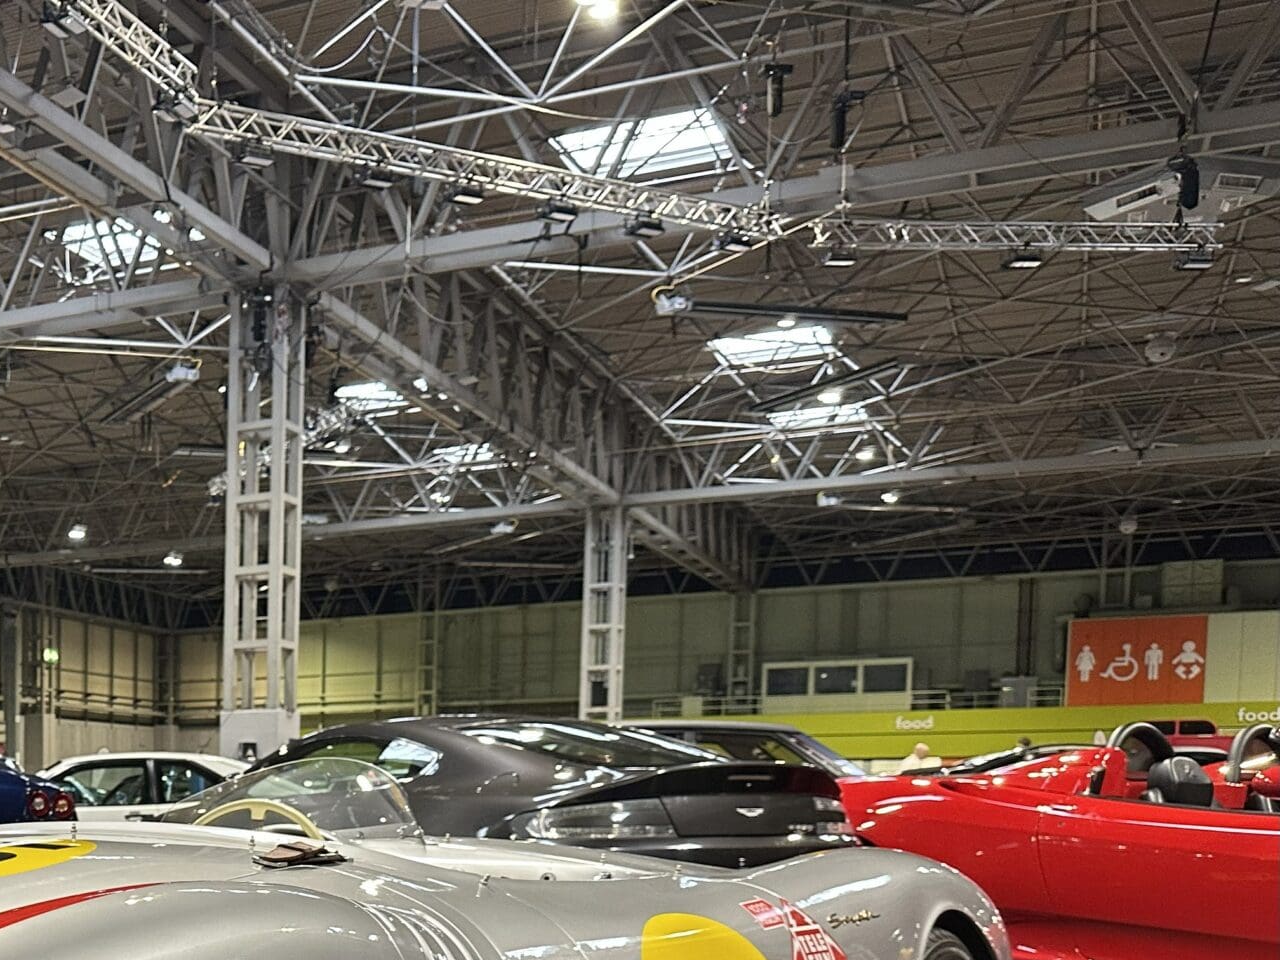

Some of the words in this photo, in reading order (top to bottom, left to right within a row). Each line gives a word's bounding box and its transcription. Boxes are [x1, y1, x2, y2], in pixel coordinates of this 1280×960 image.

[1238, 706, 1280, 721] food
[896, 715, 934, 730] food
[799, 933, 828, 953] TELE
